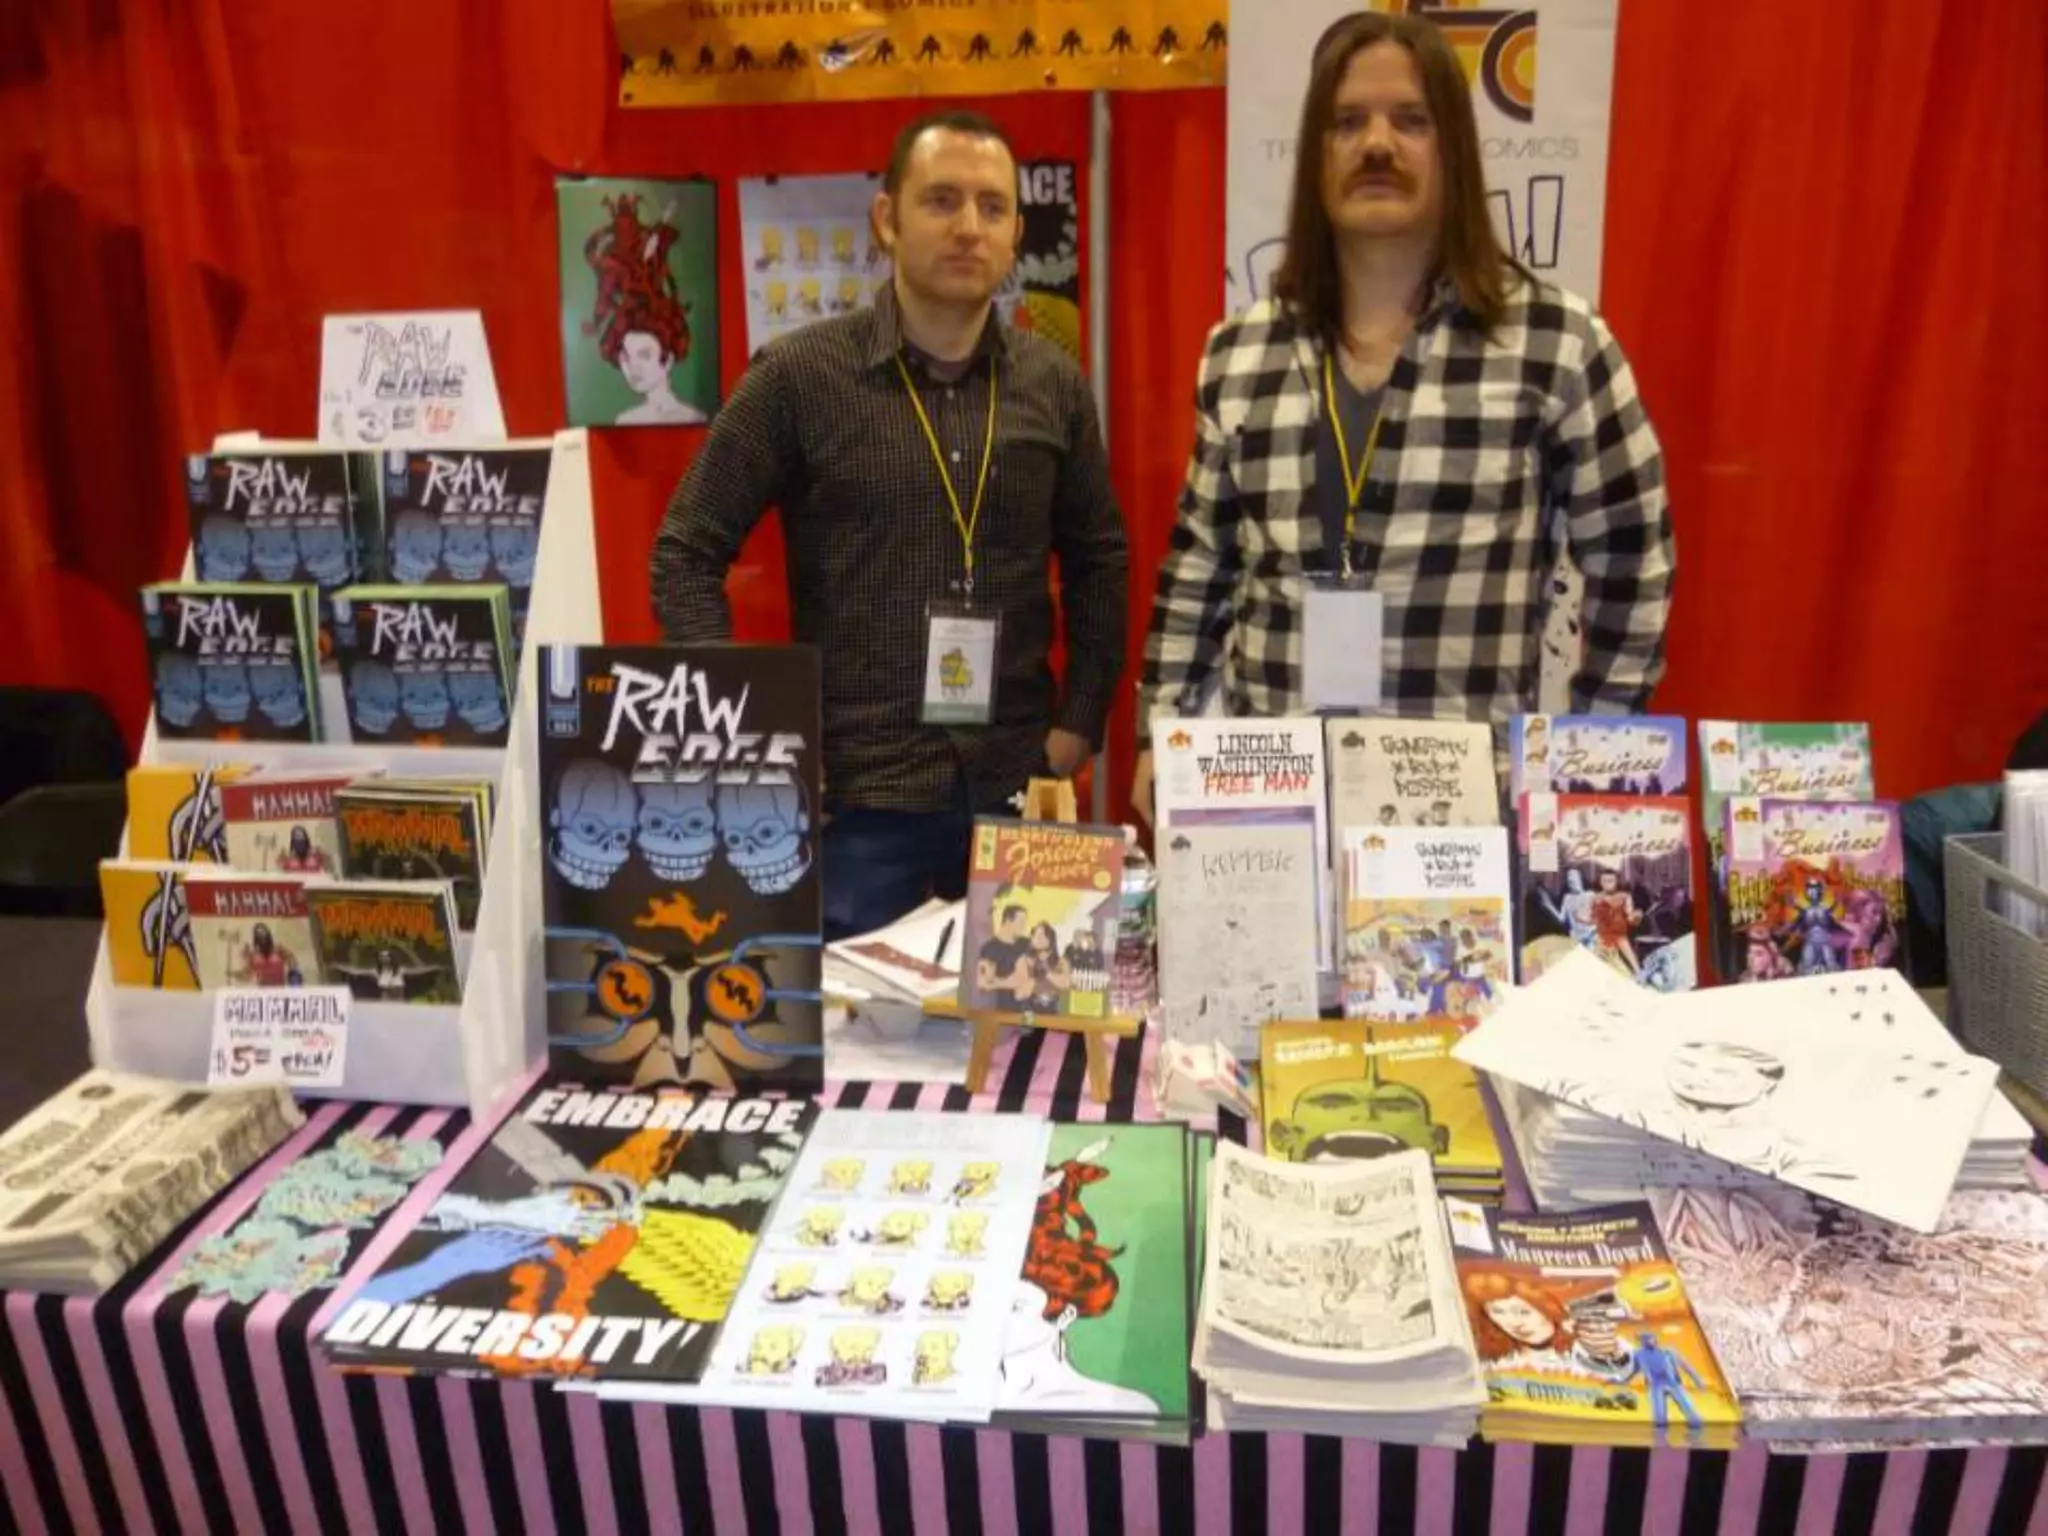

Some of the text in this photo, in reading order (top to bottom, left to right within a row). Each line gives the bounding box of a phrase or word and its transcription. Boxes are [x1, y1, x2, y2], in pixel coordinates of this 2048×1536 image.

[1481, 136, 1579, 160] OMICS
[224, 457, 311, 512] RAW
[420, 453, 509, 508] RAW
[176, 594, 261, 648] RAW
[369, 601, 458, 656] RAW
[600, 660, 751, 752] RAW
[630, 733, 807, 786] EDGE
[1217, 733, 1293, 755] LINCOLN
[1197, 754, 1315, 778] WASHINGTON
[1554, 749, 1664, 778] Business
[1204, 769, 1310, 796] FREE MAN
[1748, 767, 1857, 796] Business
[1567, 829, 1678, 862] Business
[1773, 828, 1883, 858] Business
[214, 889, 300, 918] MAMMAL
[523, 1089, 807, 1134] EMBRACE
[1500, 1234, 1655, 1266] Maureen Dowd
